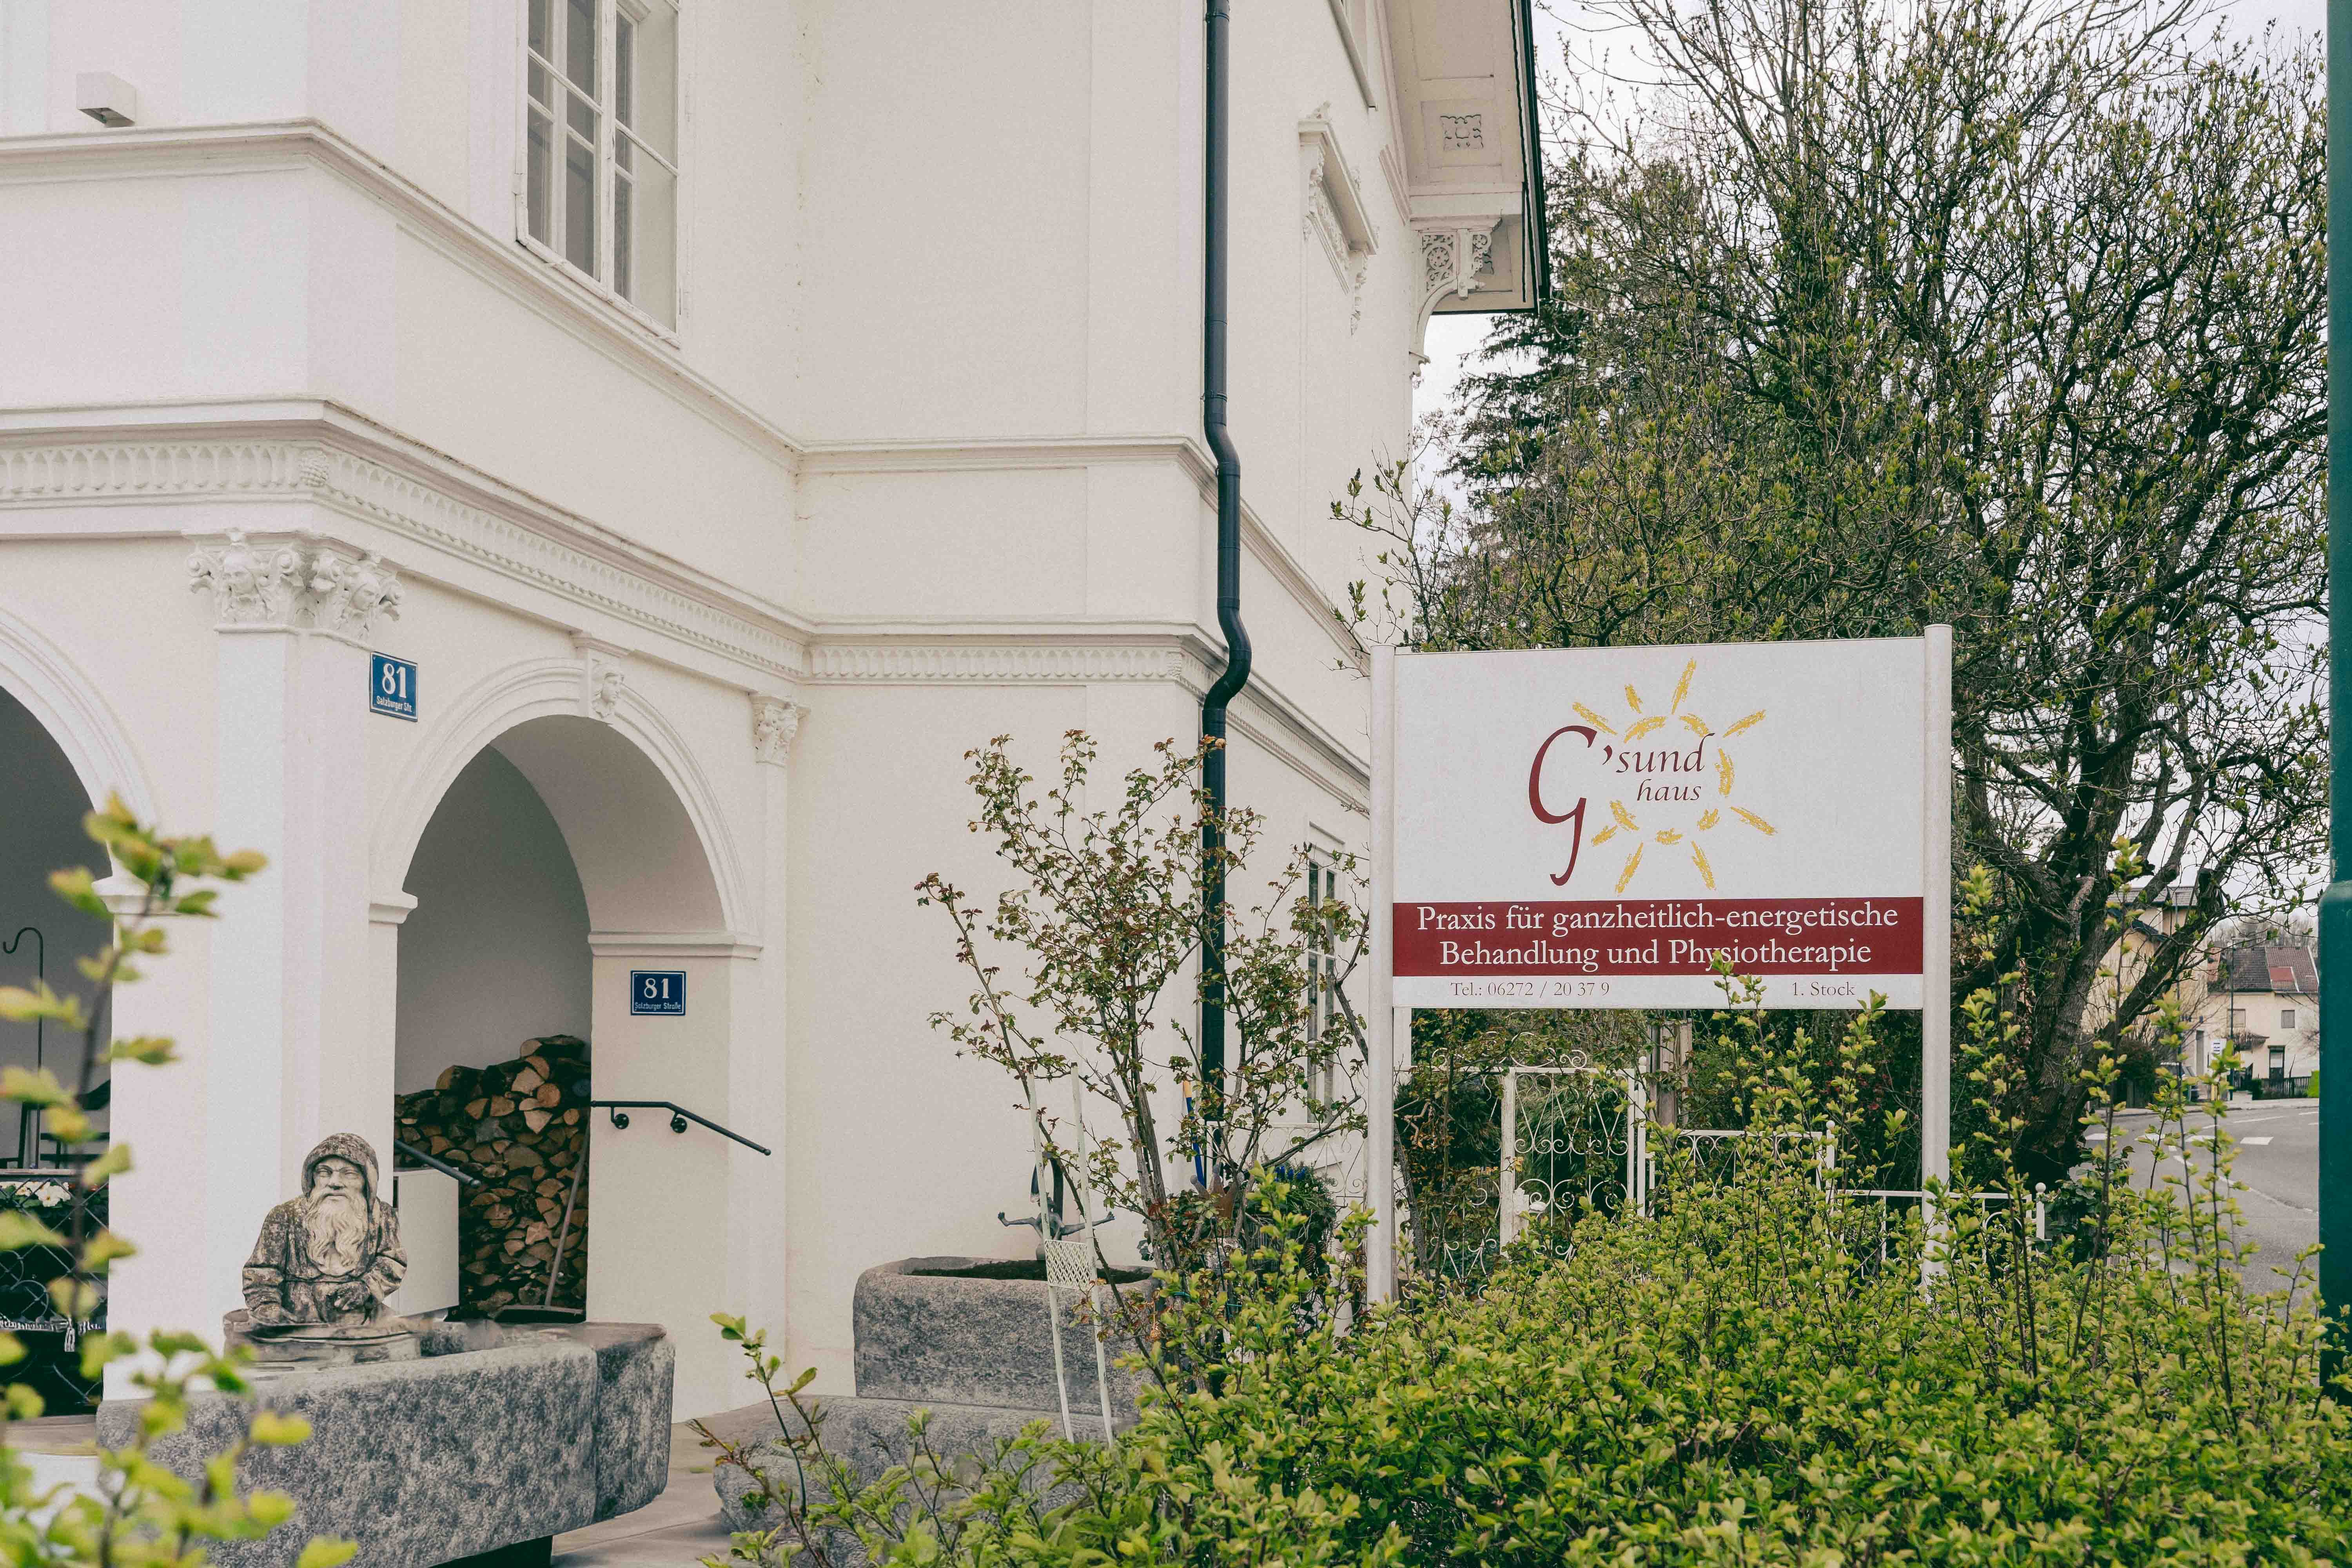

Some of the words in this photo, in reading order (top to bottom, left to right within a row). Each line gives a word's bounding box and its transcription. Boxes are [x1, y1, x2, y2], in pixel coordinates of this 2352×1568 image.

[382, 663, 407, 698] 81
[1637, 779, 1701, 800] haus
[1417, 906, 1495, 930] Praxis
[1506, 905, 1544, 929] für
[1552, 901, 1898, 937] ganzheitlich-energetische
[1440, 940, 1599, 973] Behandlung
[1607, 939, 1659, 964] und
[1668, 938, 1872, 971] Physiotherapie
[644, 978, 669, 998] 81
[1450, 982, 1482, 996] Tel.:
[1488, 982, 1534, 996] 06272
[1540, 981, 1547, 998] /
[1554, 982, 1572, 996] 20
[1577, 982, 1595, 996] 37
[1602, 982, 1609, 996] 9
[1793, 982, 1804, 996] 1.
[1811, 981, 1855, 996] Stock
